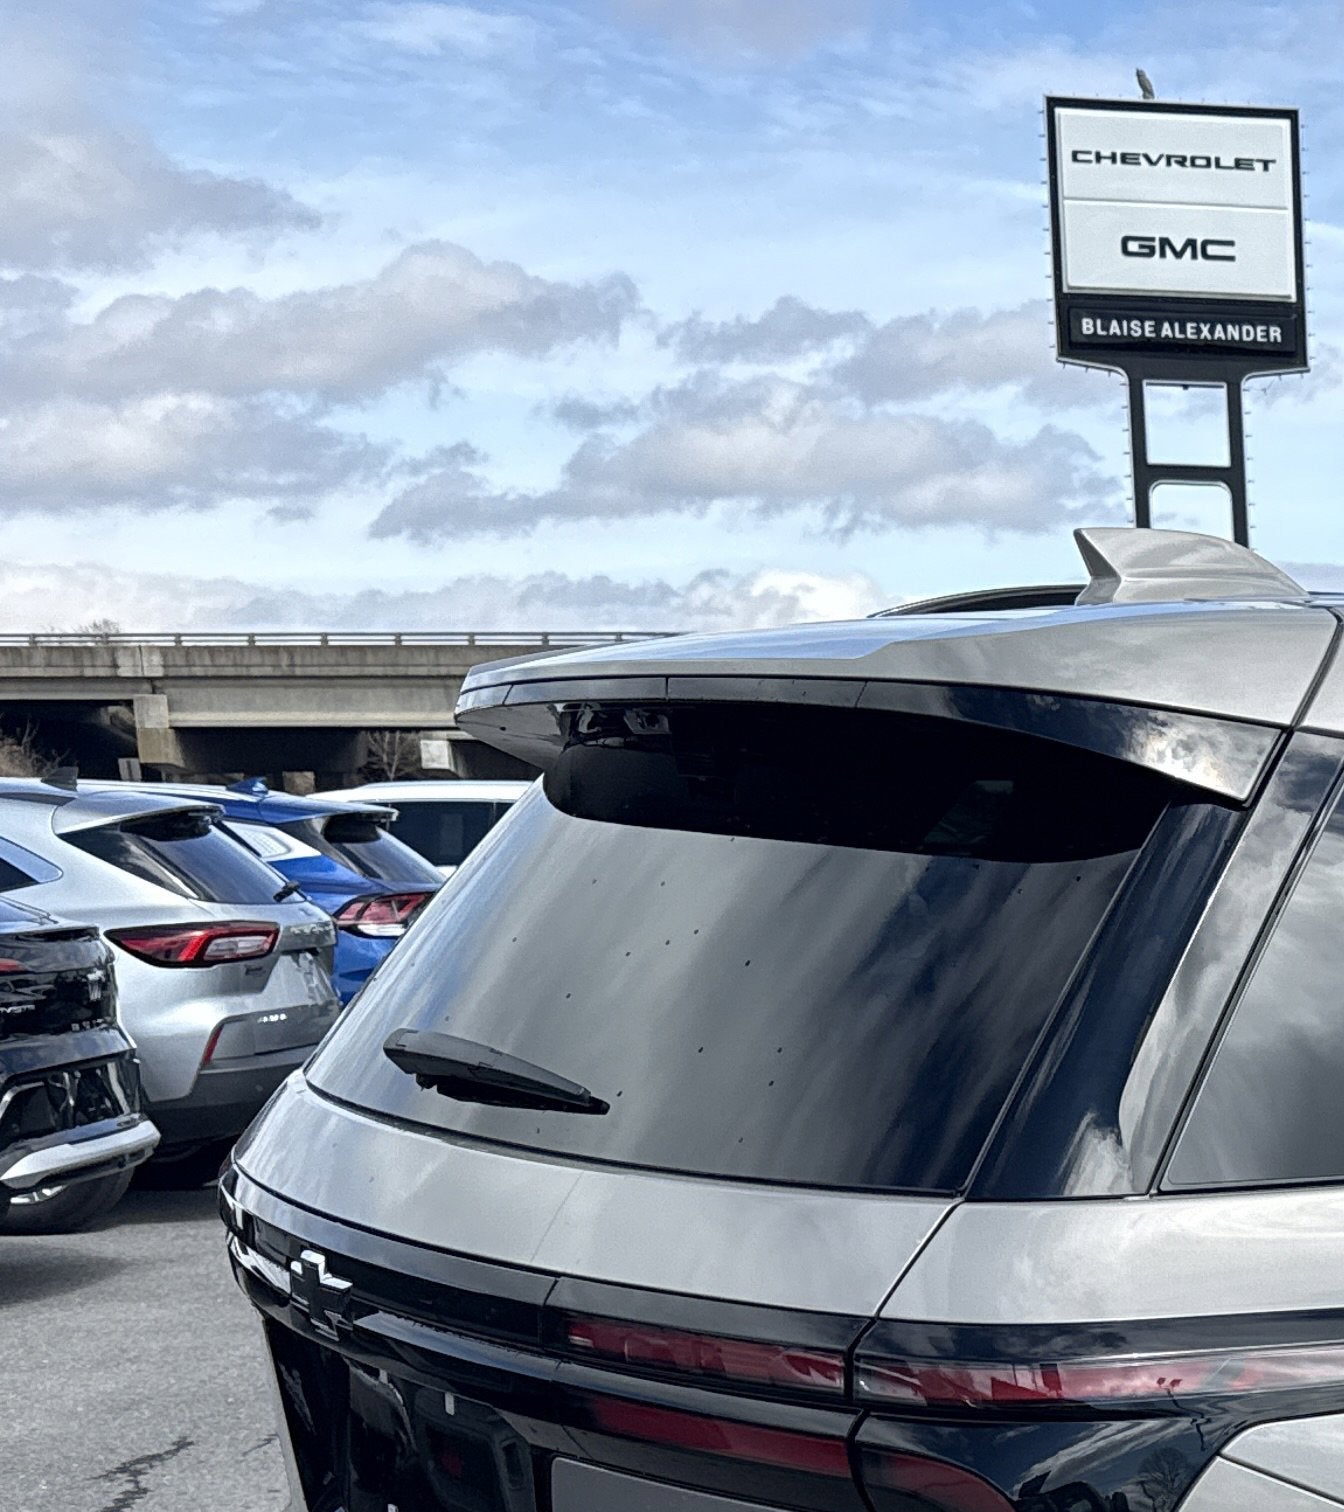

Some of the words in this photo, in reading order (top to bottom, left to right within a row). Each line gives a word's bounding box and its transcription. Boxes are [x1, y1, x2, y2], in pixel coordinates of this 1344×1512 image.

[1071, 149, 1277, 172] CHEVROLET
[1120, 235, 1236, 262] GMC
[1081, 317, 1156, 337] BLAISE
[1161, 319, 1282, 342] ALEXANDER
